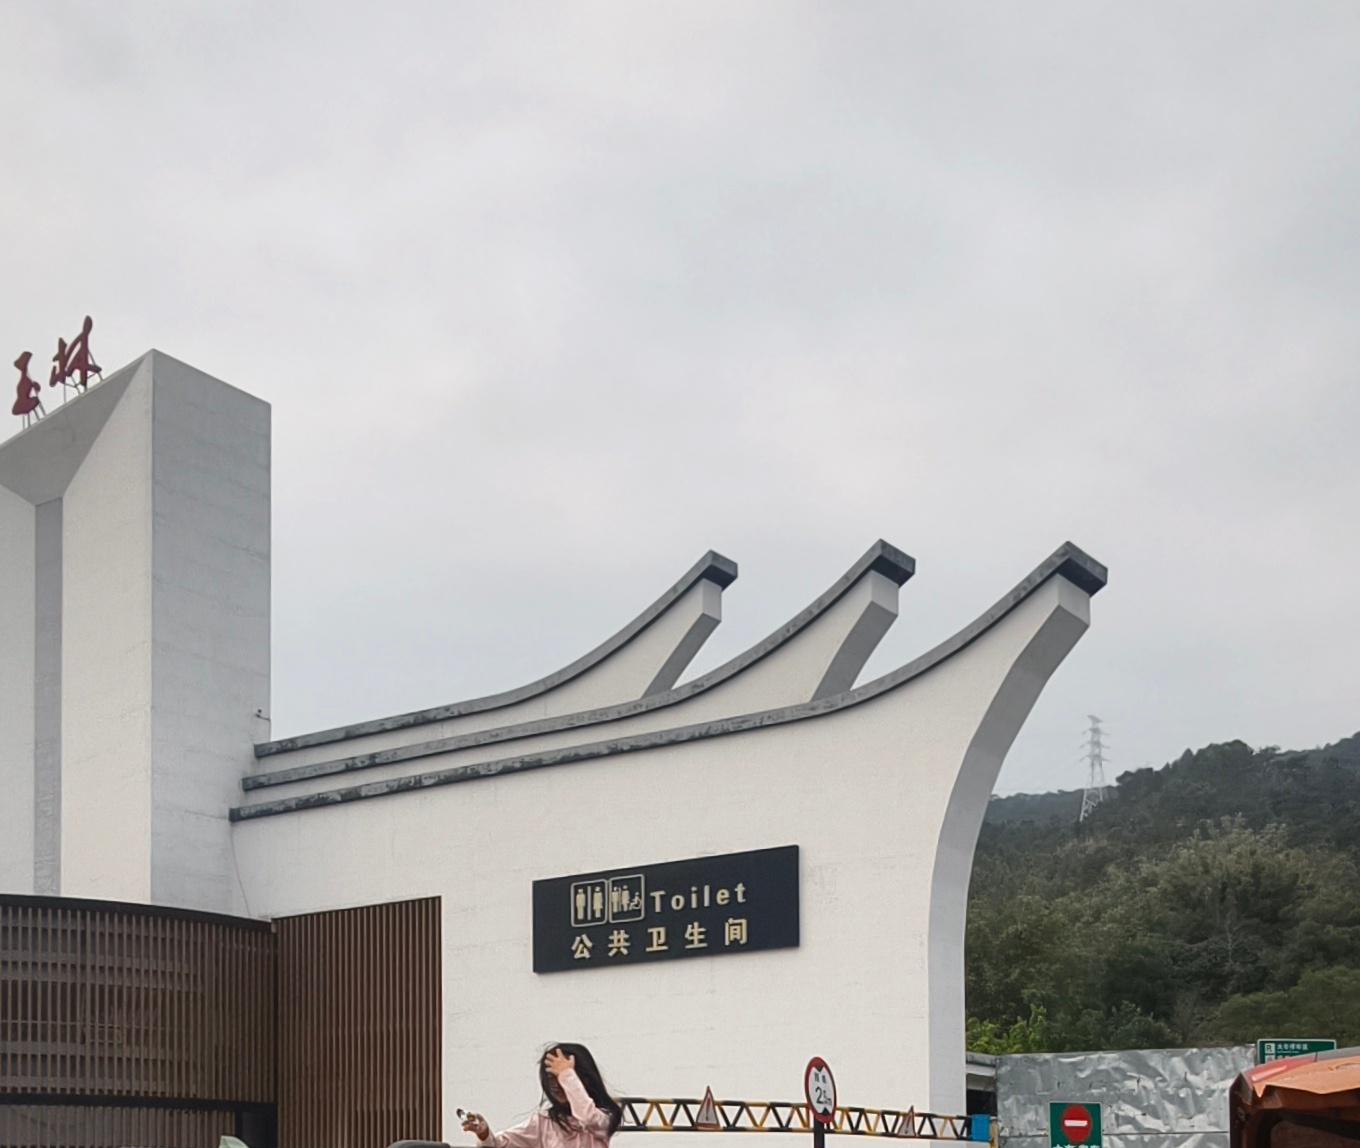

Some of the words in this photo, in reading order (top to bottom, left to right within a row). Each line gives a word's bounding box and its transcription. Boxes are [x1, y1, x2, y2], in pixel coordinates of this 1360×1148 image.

[650, 882, 746, 913] Toilet
[571, 918, 748, 959] 公共卫生间
